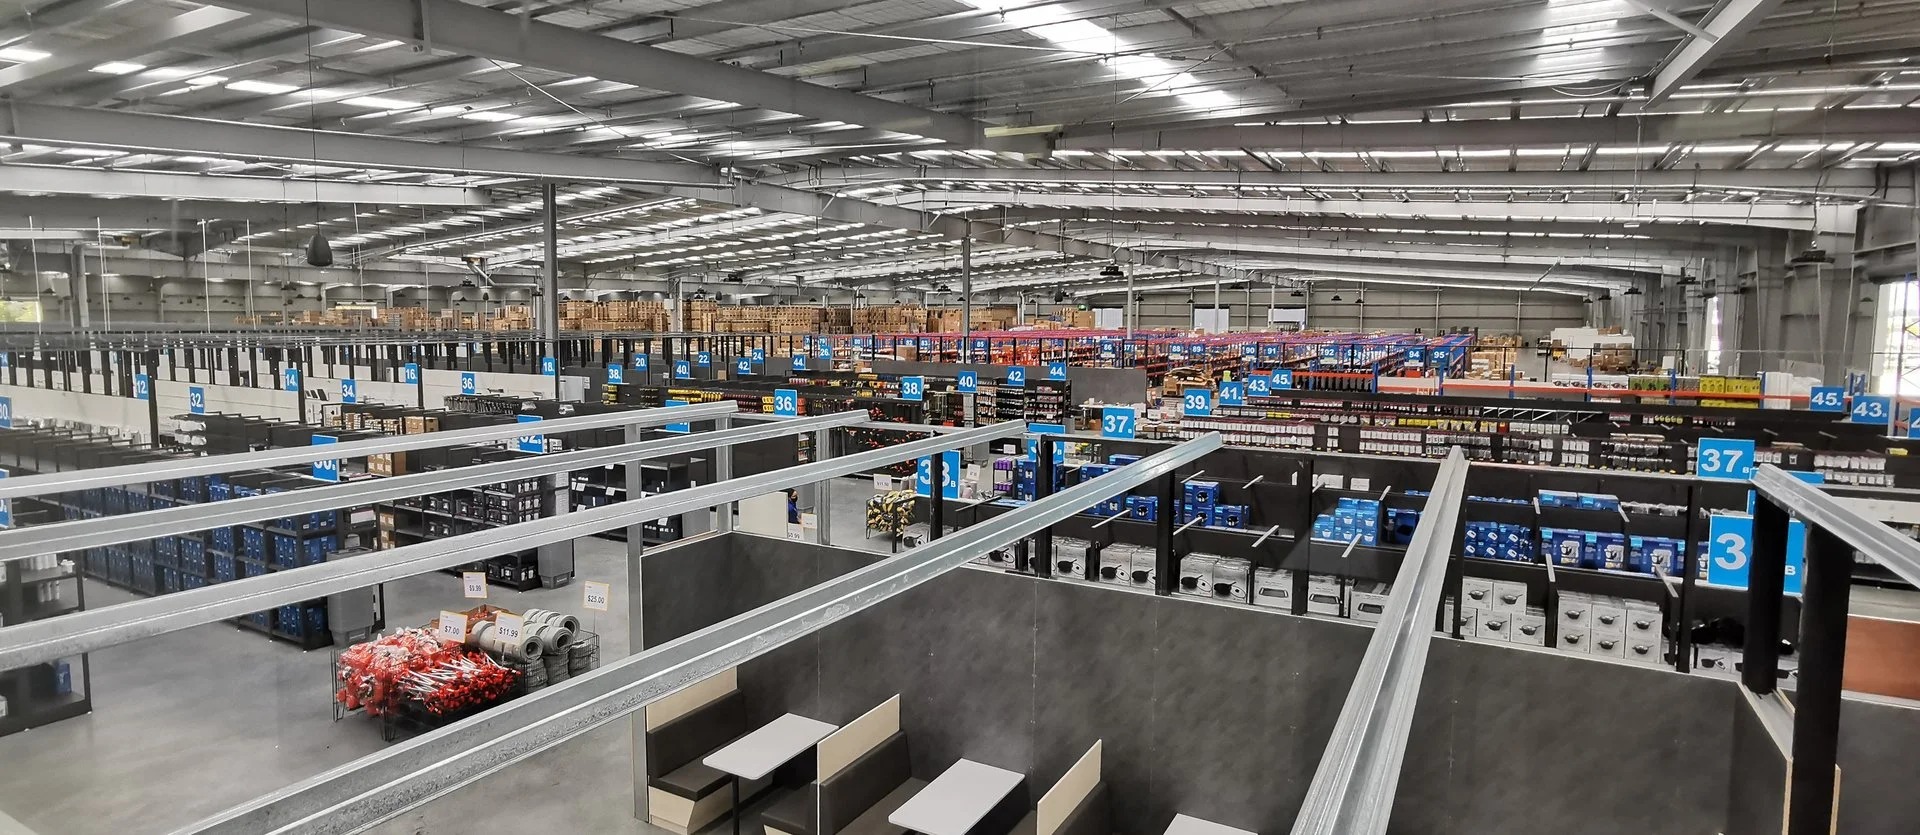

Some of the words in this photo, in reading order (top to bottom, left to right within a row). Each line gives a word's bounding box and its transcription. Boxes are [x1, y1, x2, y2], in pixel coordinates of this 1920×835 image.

[587, 594, 605, 605] $25.00
[444, 625, 460, 635] $7.00
[499, 626, 518, 639] $11.99
